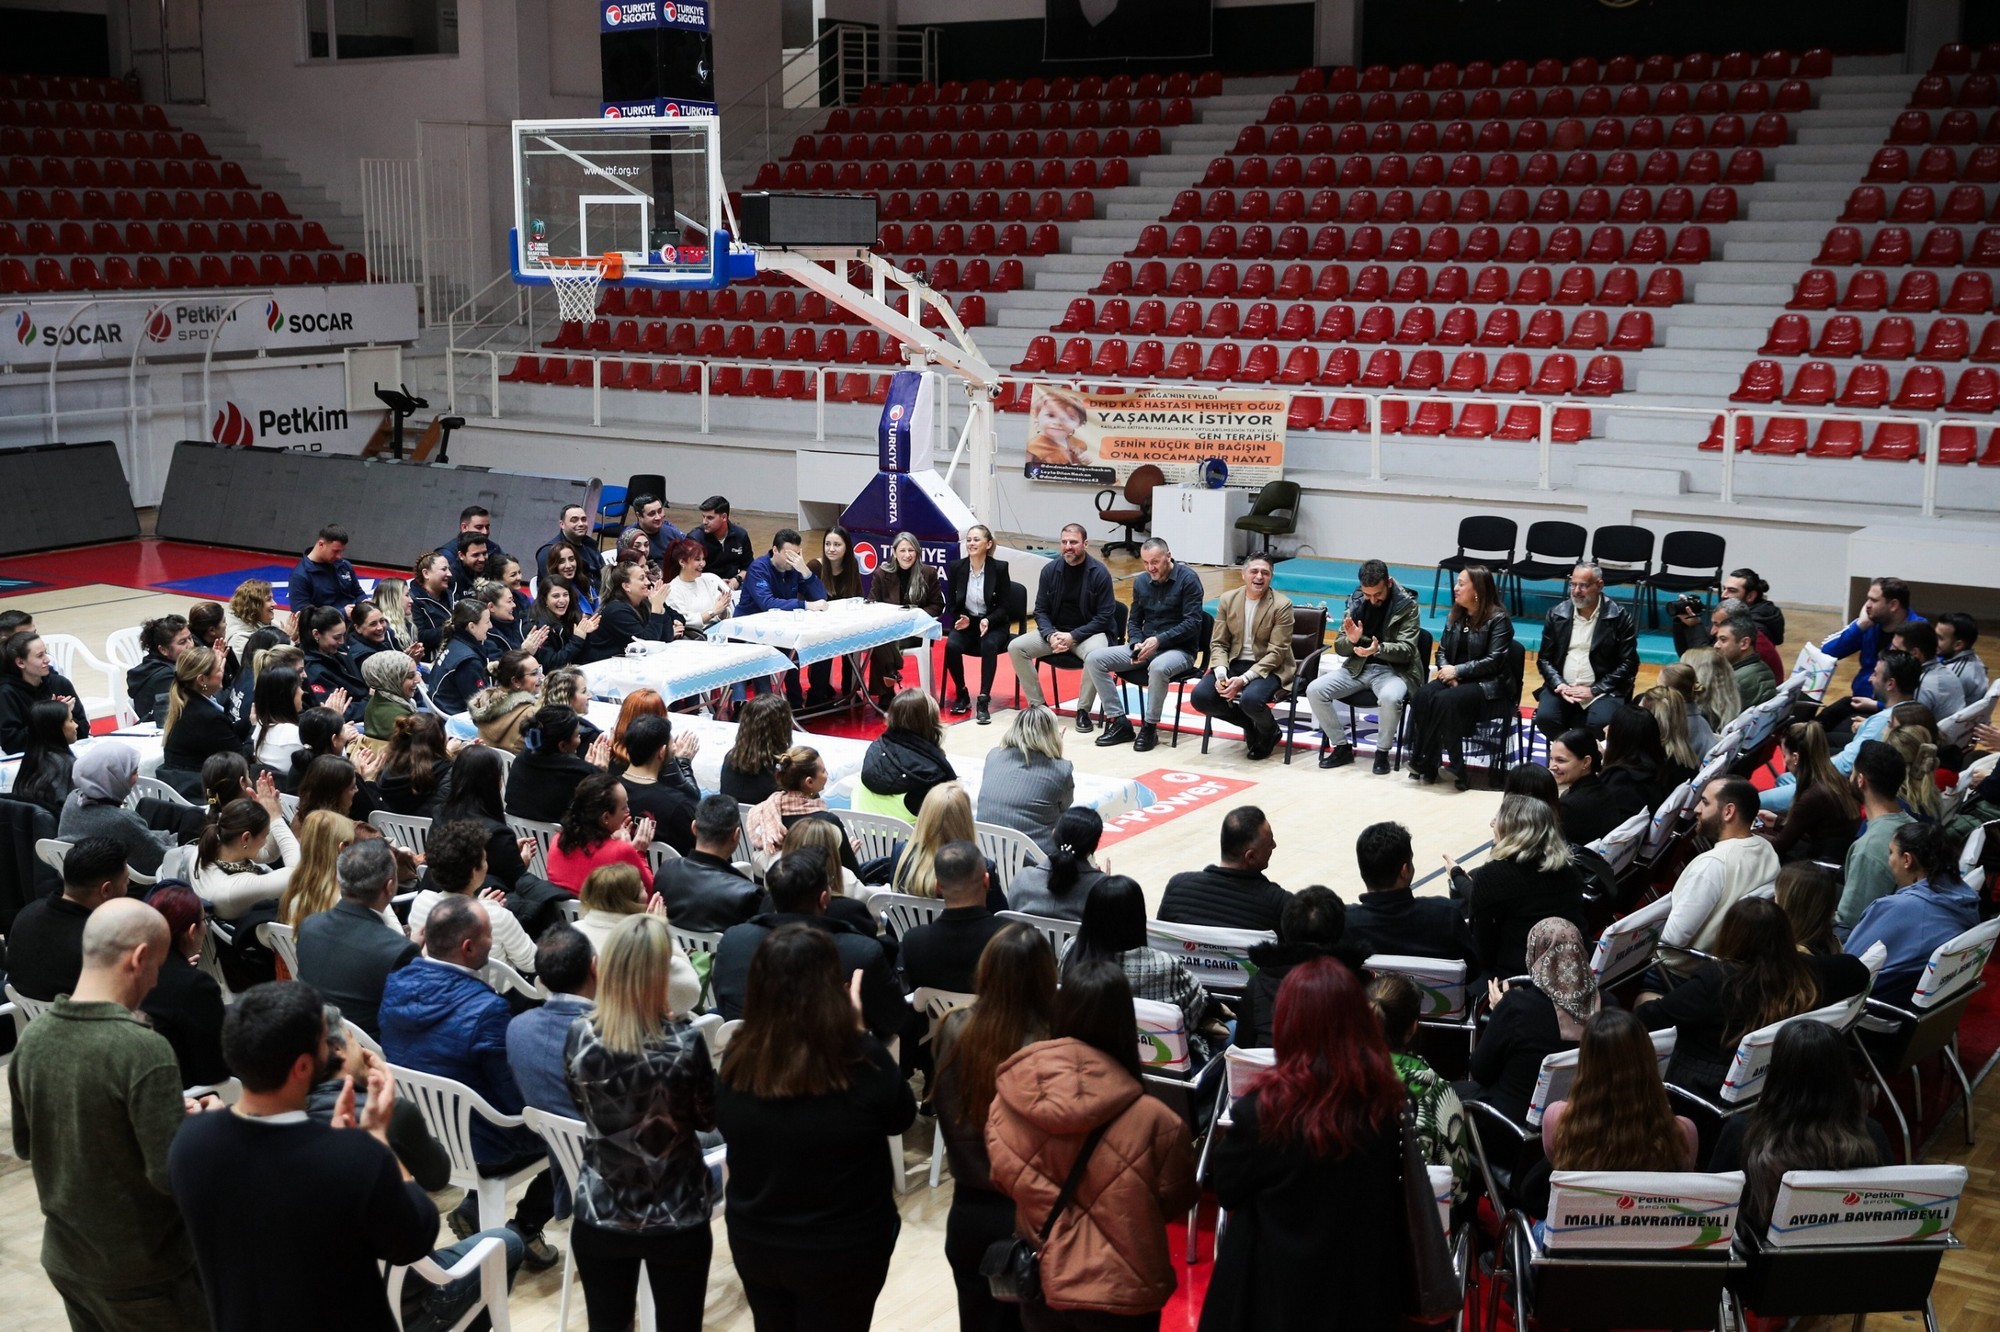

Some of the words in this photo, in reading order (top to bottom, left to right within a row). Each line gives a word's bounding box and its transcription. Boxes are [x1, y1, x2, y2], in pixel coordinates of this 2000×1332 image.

[584, 166, 640, 177] www.tbf.org.tr
[289, 312, 353, 333] SOCAR
[43, 322, 122, 346] SOCAR
[1196, 402, 1242, 410] MEHMET
[1247, 401, 1280, 410] OĞUZ
[260, 406, 348, 437] Petkim
[1098, 412, 1194, 425] YAŞAMAK
[1199, 412, 1272, 425] İSTİYOR
[1114, 439, 1146, 448] SENİN
[1150, 440, 1190, 451] KÜÇÜK
[1218, 443, 1266, 453] BAĞIŞIN
[1144, 452, 1204, 461] KOCAMAN
[1638, 1196, 1679, 1204] Petkim
[1864, 1192, 1904, 1200] Petkim
[1564, 1213, 1614, 1227] MALİK
[1620, 1214, 1729, 1228] BAYRAMBEYLİ
[1789, 1212, 1839, 1226] AYDAN
[1844, 1208, 1950, 1222] BAYRAMBEYLİ
